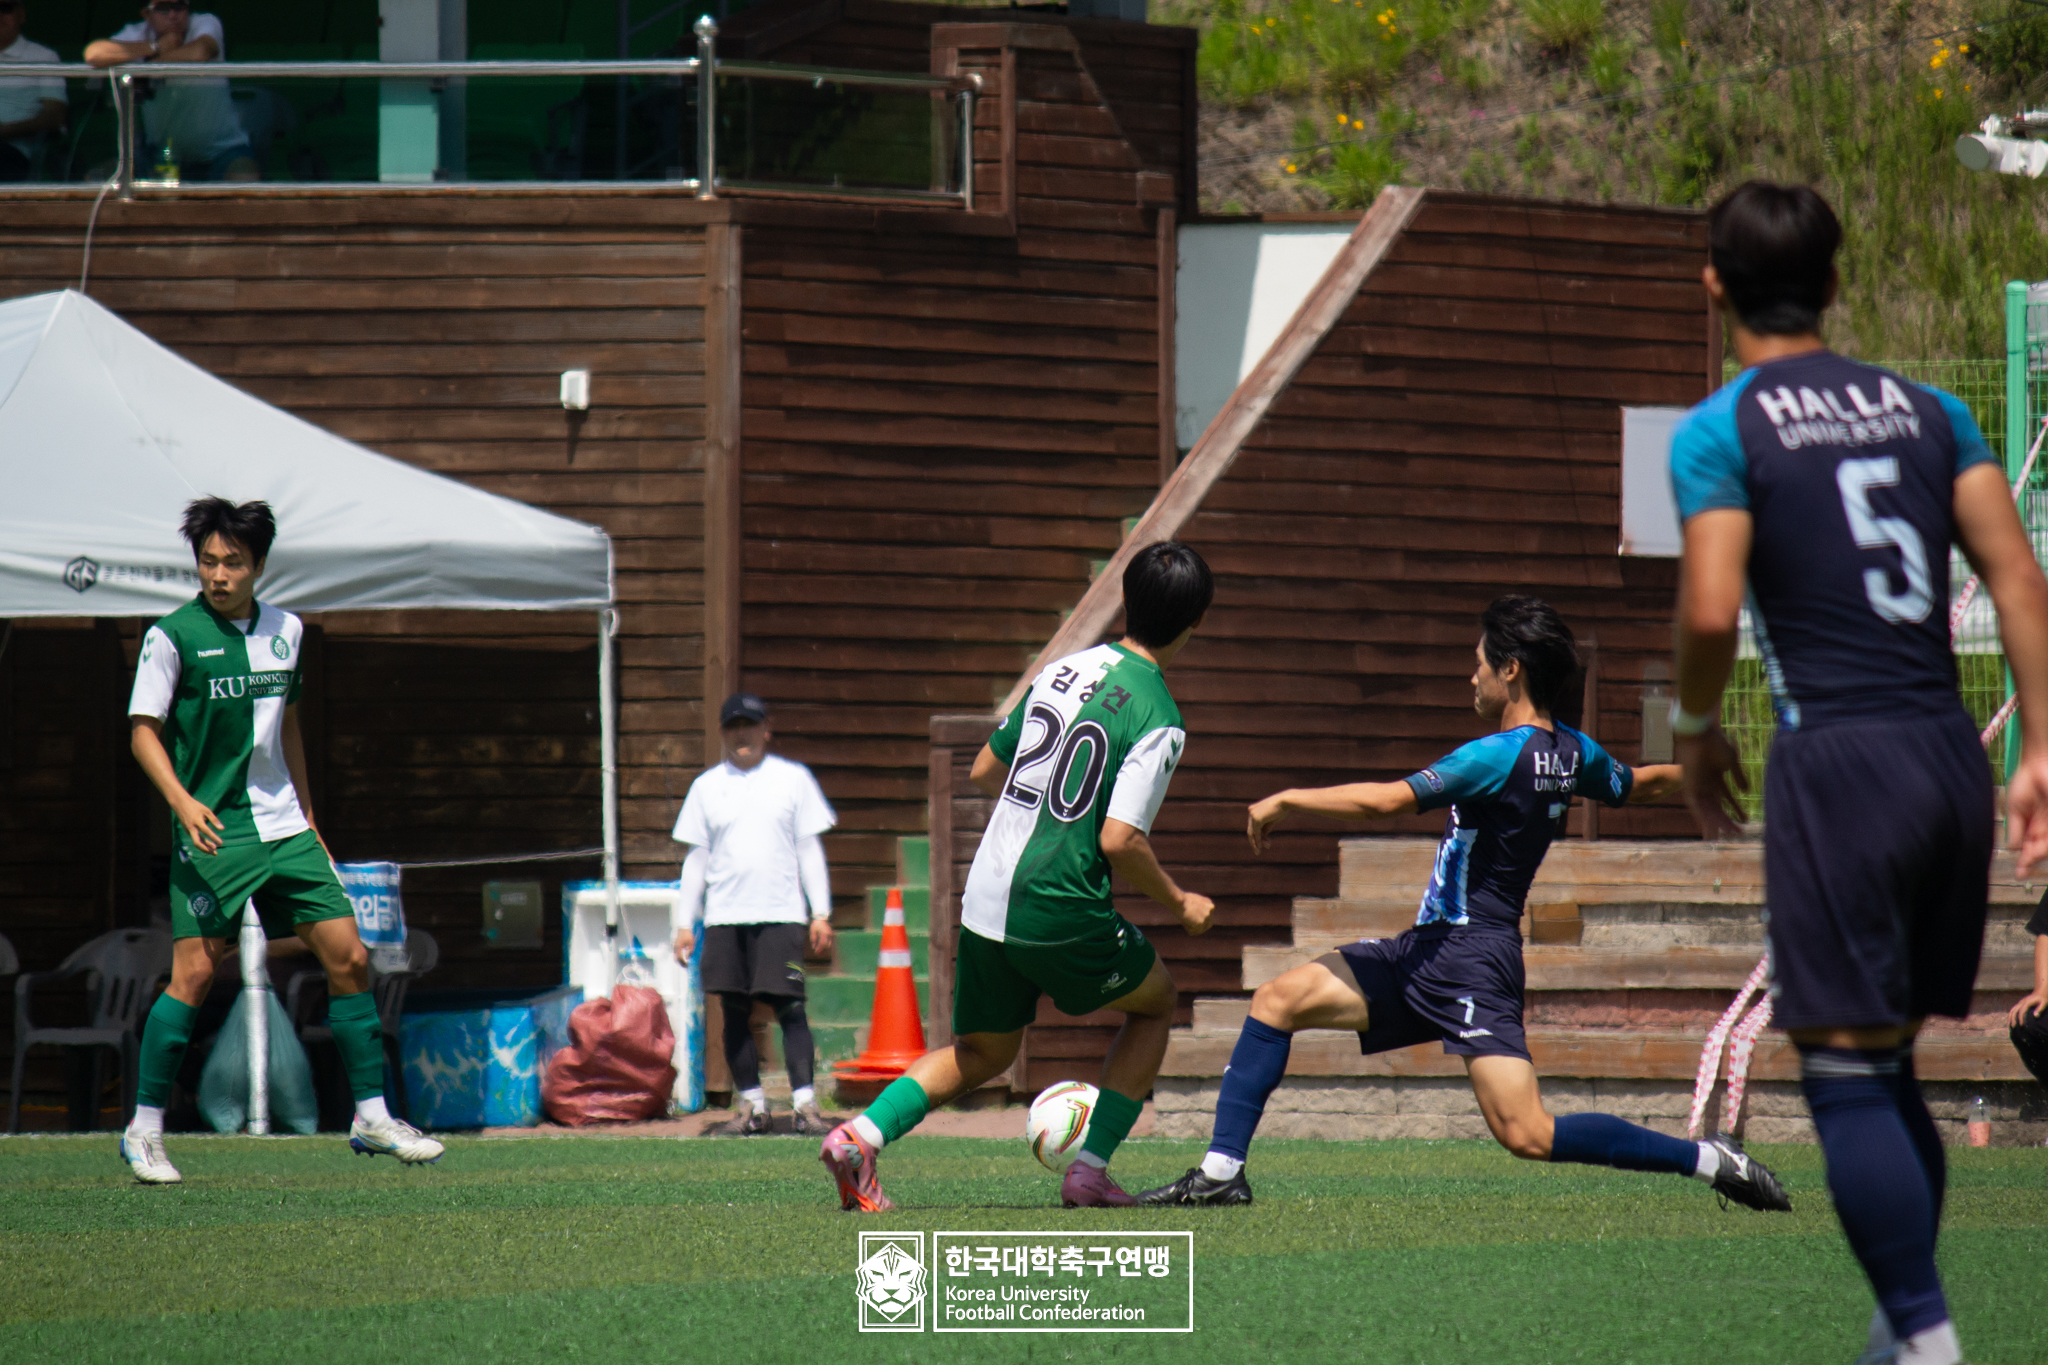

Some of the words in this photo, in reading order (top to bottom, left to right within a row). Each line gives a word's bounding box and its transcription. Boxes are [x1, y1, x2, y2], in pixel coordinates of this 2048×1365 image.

[1756, 376, 1914, 427] HALLA
[1777, 414, 1921, 450] UNIVERSITY
[1836, 456, 1934, 625] 5
[208, 676, 246, 700] KU
[1050, 665, 1133, 716] 김상건
[1003, 701, 1109, 822] 20
[1456, 996, 1475, 1026] 7
